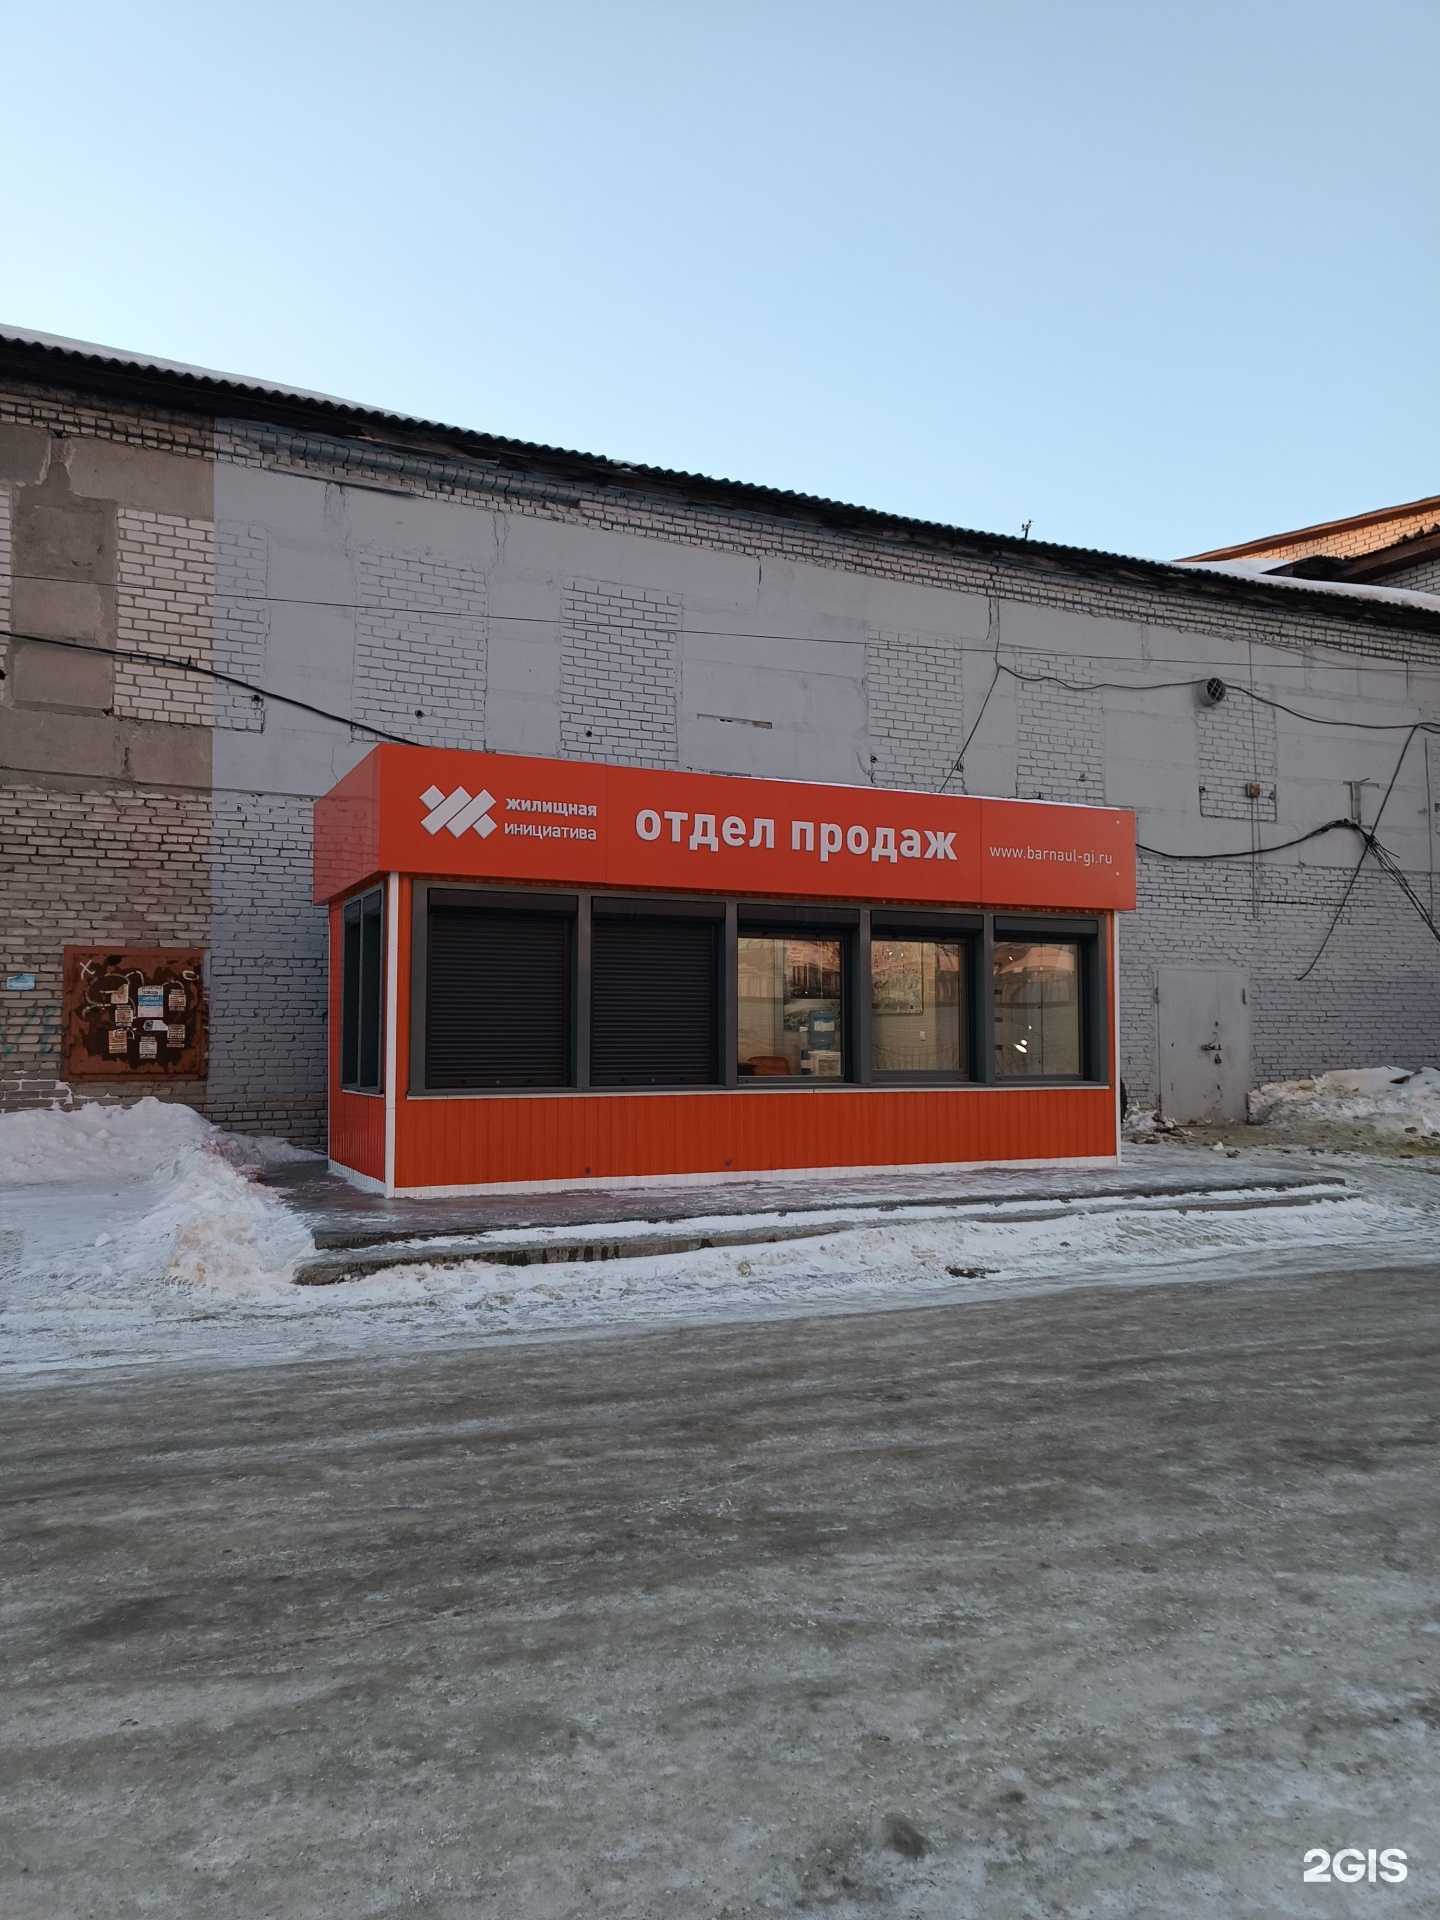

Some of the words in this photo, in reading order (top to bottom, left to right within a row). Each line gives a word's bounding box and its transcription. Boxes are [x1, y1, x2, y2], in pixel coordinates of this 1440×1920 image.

[505, 797, 598, 817] жилищная
[504, 822, 597, 841] инициатива
[635, 808, 776, 852] отдел
[790, 818, 958, 863] продаж
[989, 844, 1113, 866] www.barnaul-gi.ru
